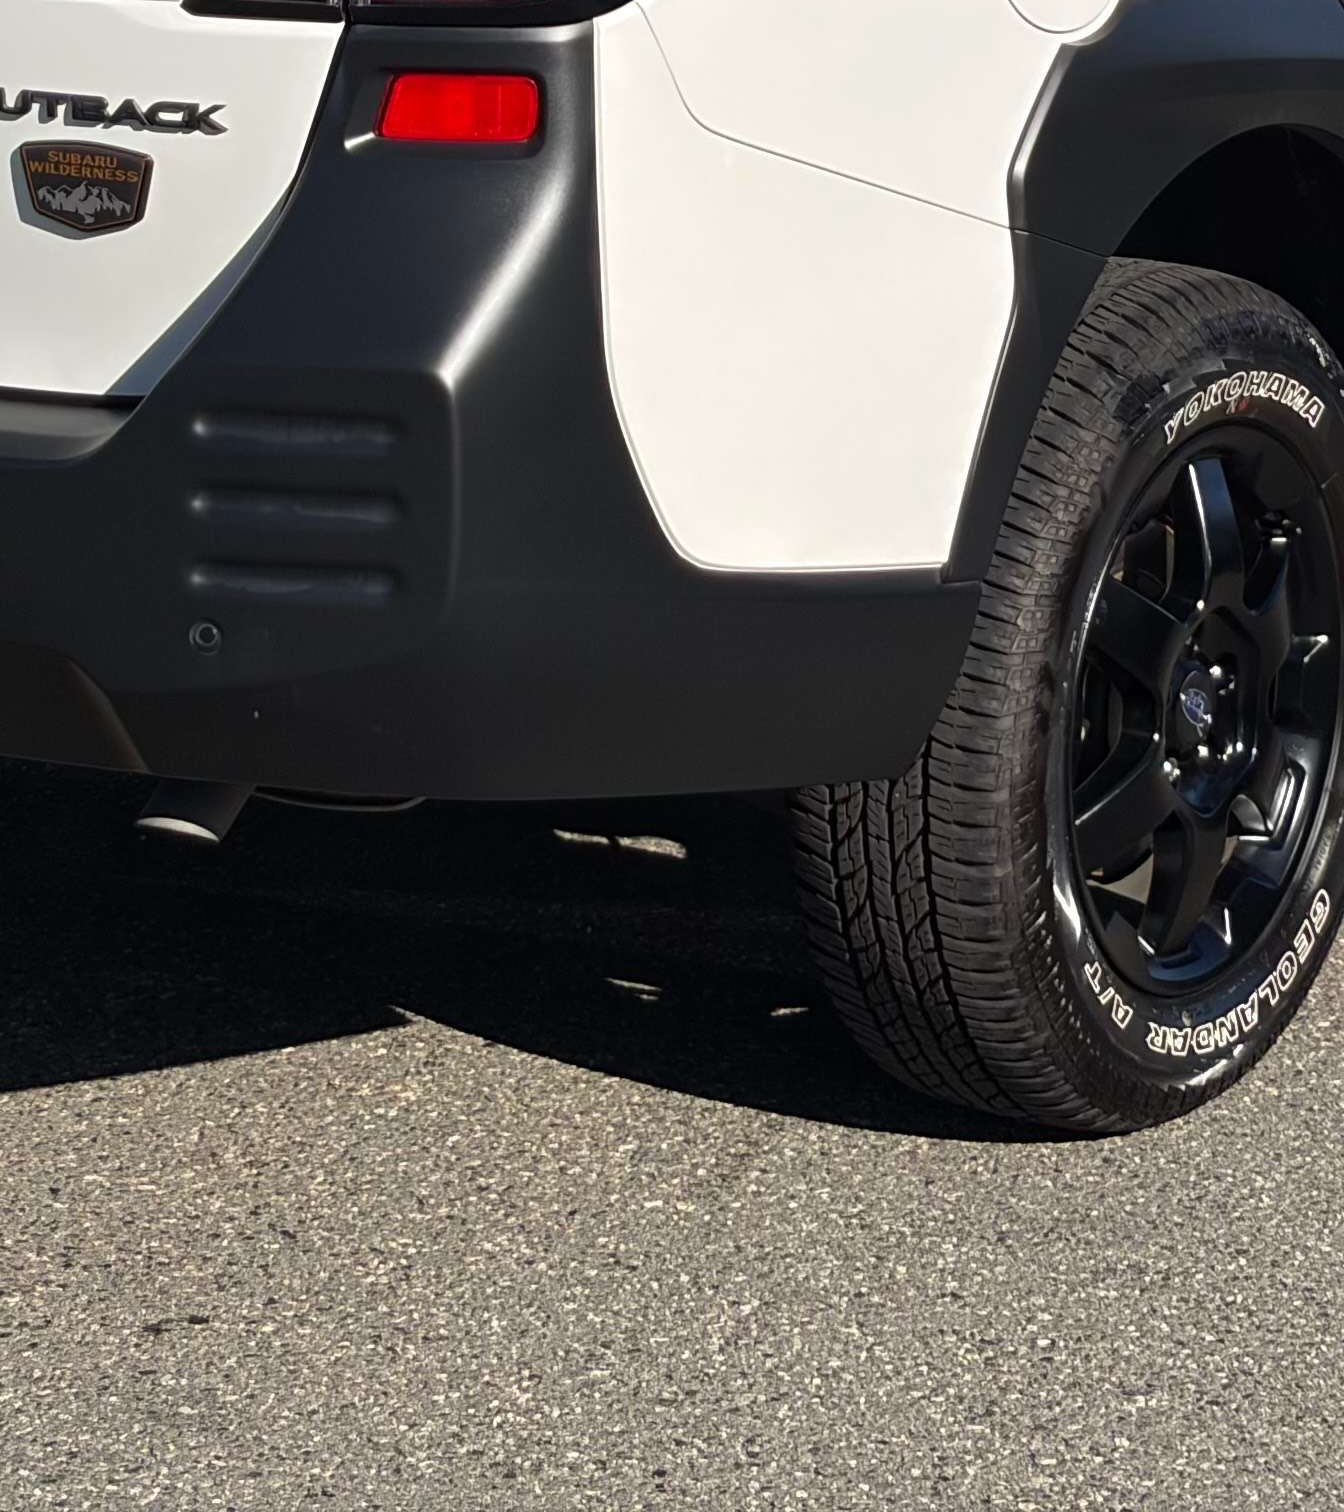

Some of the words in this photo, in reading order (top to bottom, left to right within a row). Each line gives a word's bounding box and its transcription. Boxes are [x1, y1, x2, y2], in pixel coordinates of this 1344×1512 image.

[29, 160, 139, 183] WILDERNESS
[47, 150, 118, 169] SUBARU
[1164, 370, 1326, 445] YOKOHAMA
[1144, 887, 1331, 1058] GEOLANDAR
